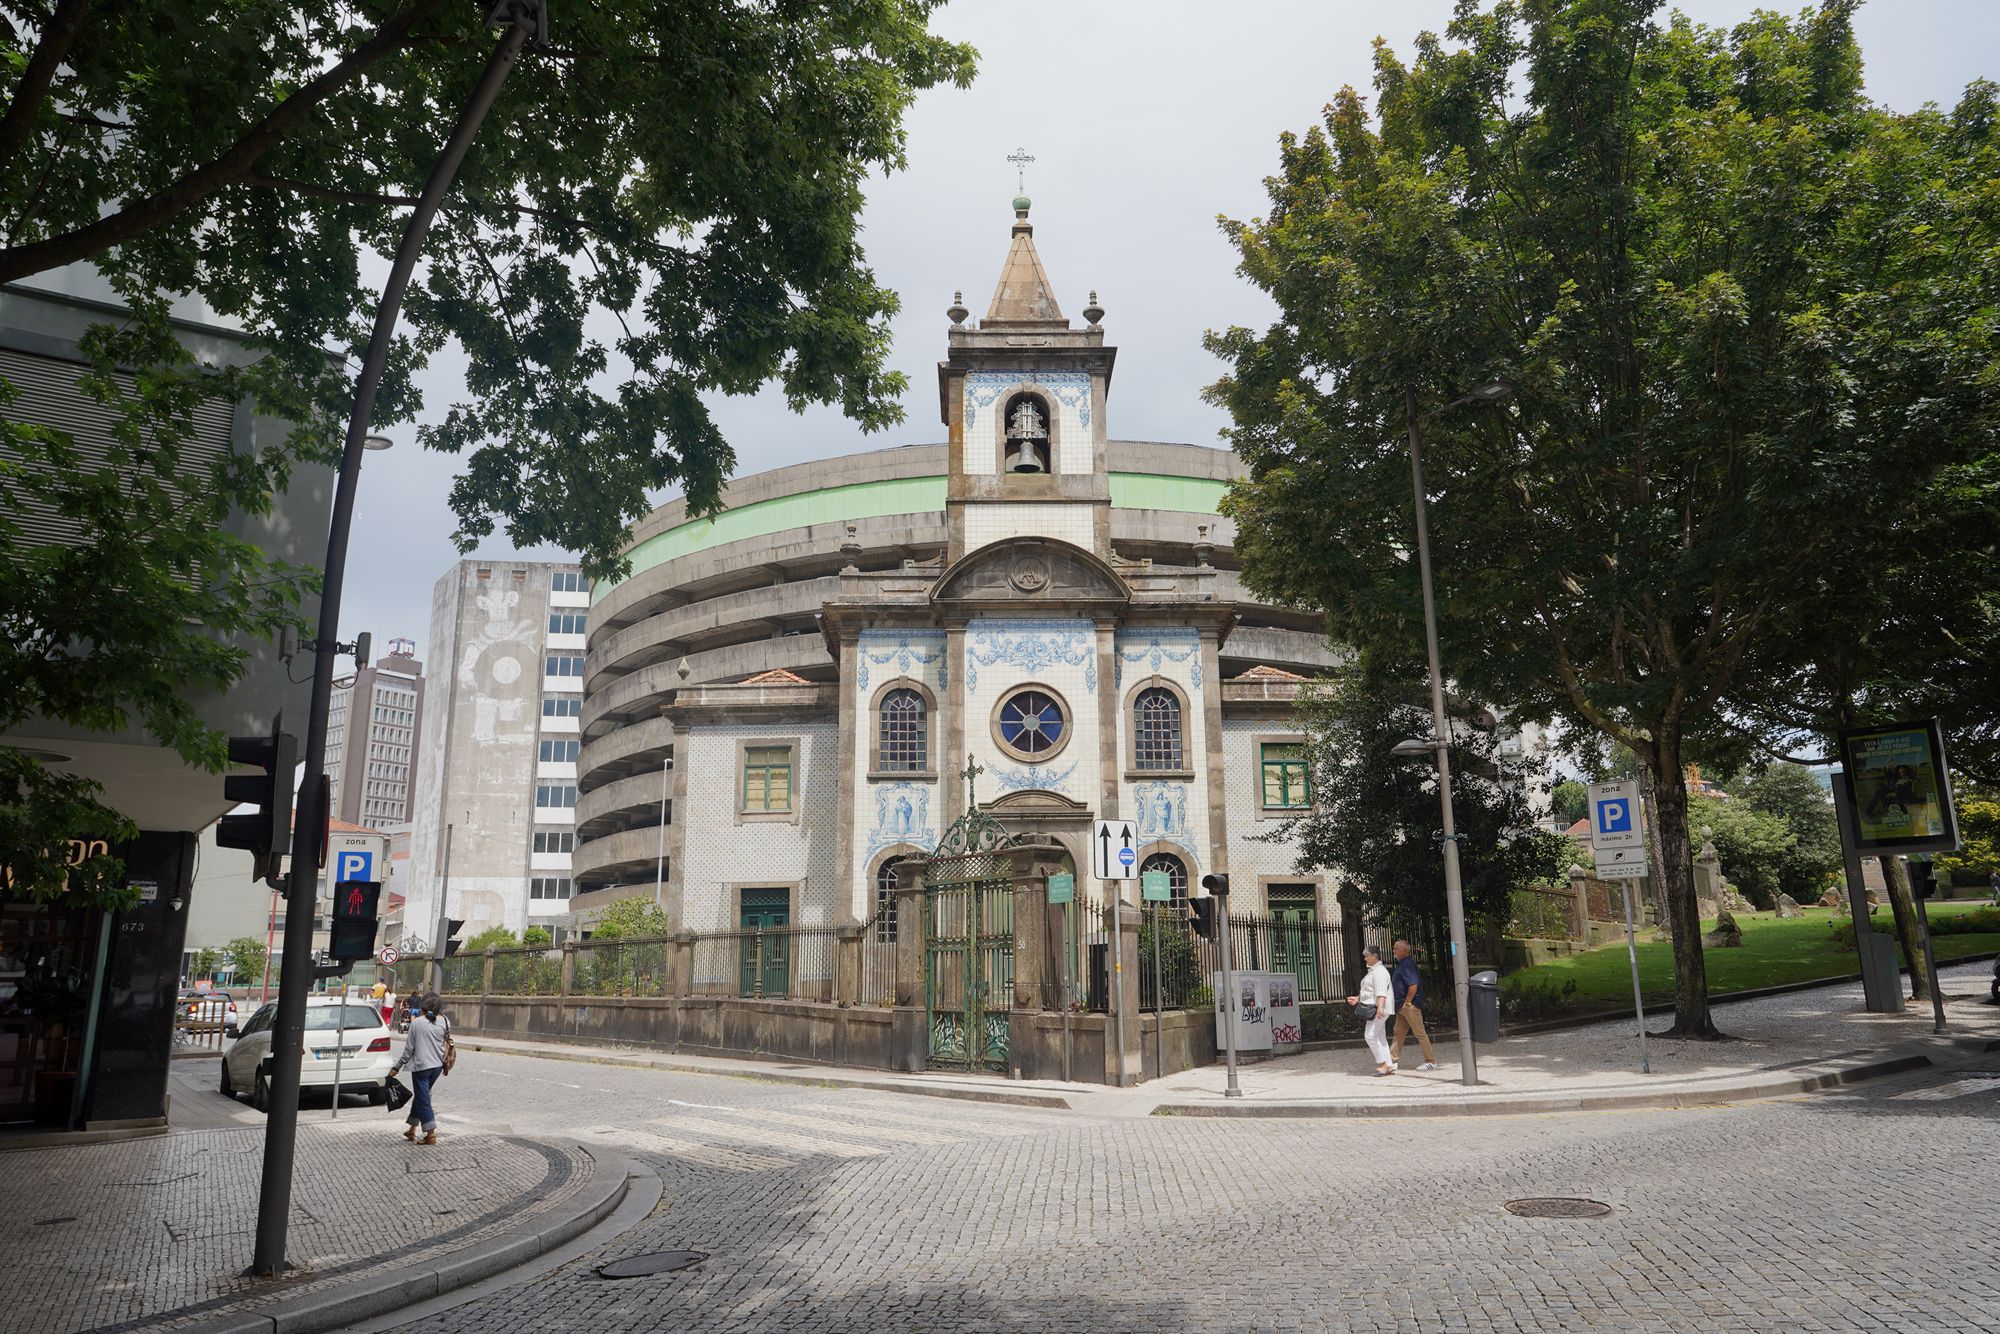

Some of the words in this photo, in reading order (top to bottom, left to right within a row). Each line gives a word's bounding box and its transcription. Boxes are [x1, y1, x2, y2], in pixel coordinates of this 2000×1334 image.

[1601, 785, 1621, 794] zona
[1603, 803, 1624, 830] P
[1600, 834, 1622, 842] máximo
[343, 855, 366, 880] P
[121, 922, 145, 932] 673
